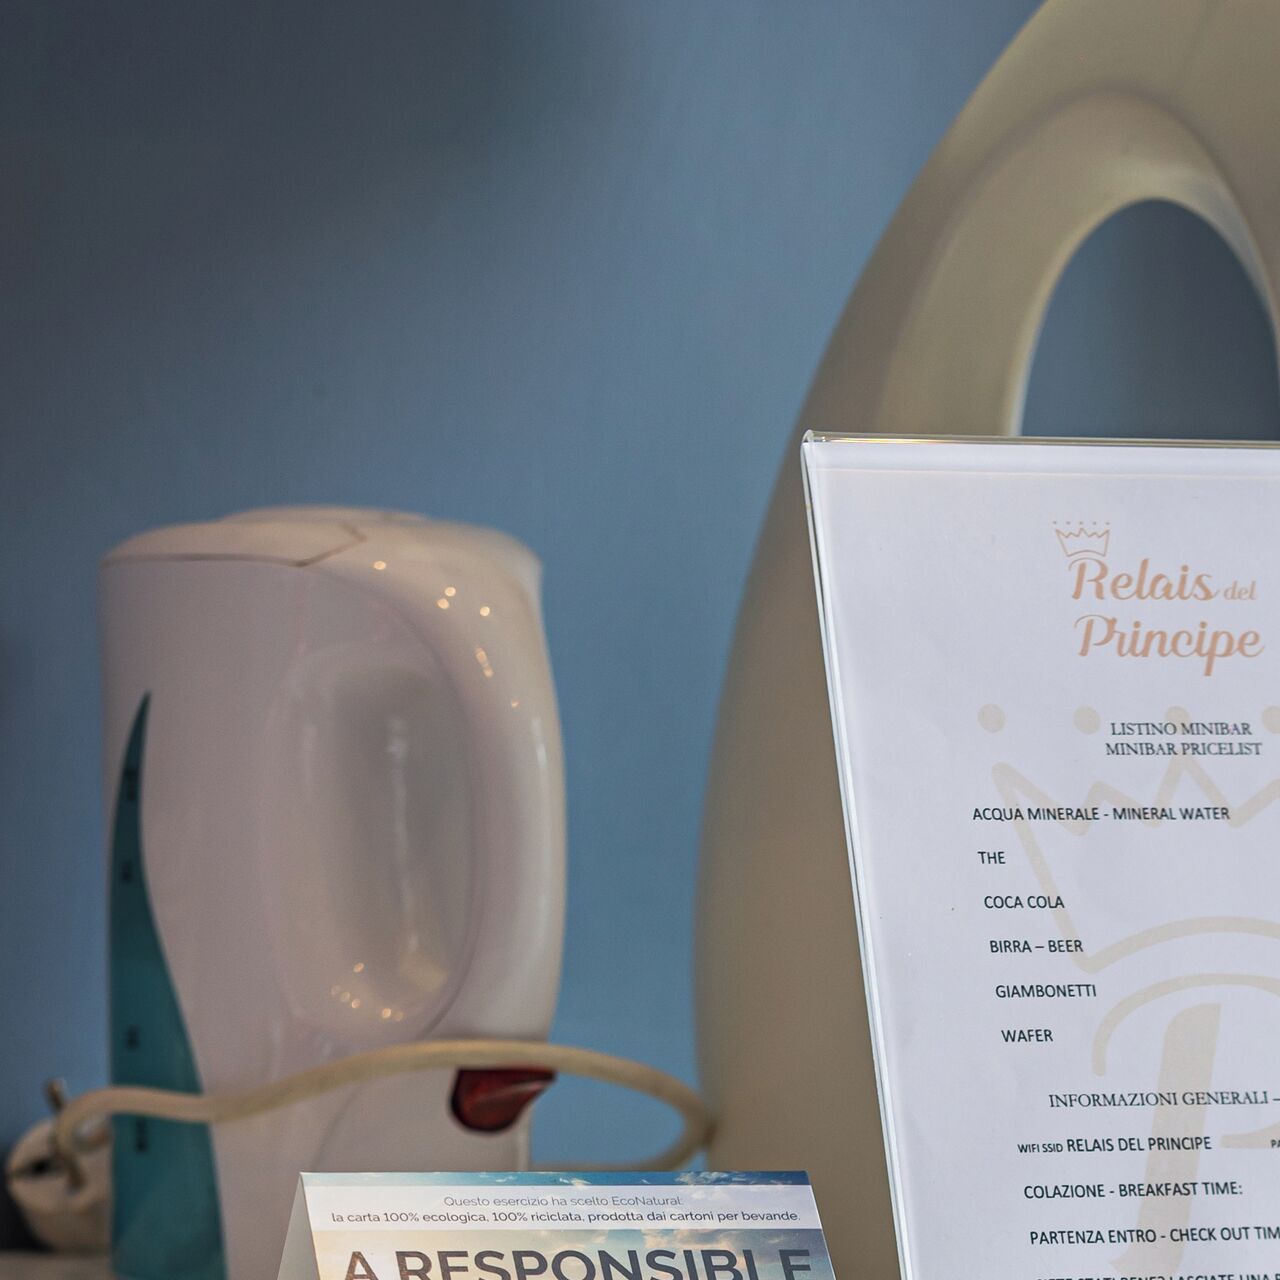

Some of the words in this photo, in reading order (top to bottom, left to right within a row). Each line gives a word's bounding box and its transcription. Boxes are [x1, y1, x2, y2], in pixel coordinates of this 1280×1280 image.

[1068, 557, 1220, 601] Relais
[1223, 580, 1257, 601] del
[1074, 614, 1266, 677] Principe
[1111, 722, 1177, 736] LISTINO
[1181, 722, 1252, 736] MINIBAR
[1105, 742, 1178, 756] MINIBAR
[1181, 742, 1263, 756] PRICELIST
[972, 807, 1024, 822] ACQUA
[1028, 807, 1100, 821] MINERALE
[1113, 807, 1177, 820] MINERAL
[1179, 807, 1231, 820] WATER
[978, 851, 1006, 865] THE
[984, 895, 1024, 909] COCA
[1027, 895, 1065, 909] COLA
[989, 940, 1032, 953] BIRRA
[1048, 939, 1084, 952] BEER
[995, 984, 1097, 998] GIAMBONETTI
[1001, 1029, 1054, 1043] WAFER
[1048, 1092, 1178, 1108] INFORMAZIONI
[1182, 1091, 1268, 1106] GENERALI
[1017, 1143, 1040, 1153] WIFI
[1042, 1143, 1063, 1153] SSID
[1066, 1138, 1114, 1152] RELAIS
[1118, 1137, 1145, 1151] DEL
[1148, 1136, 1212, 1151] PRINCIPE
[1024, 1184, 1105, 1199] COLAZIONE
[1119, 1182, 1199, 1197] BREAKFAST
[1202, 1181, 1243, 1195] TIME:
[444, 1196, 490, 1207] Questo
[493, 1195, 549, 1206] esercizio
[552, 1196, 568, 1206] ha
[570, 1195, 608, 1206] scelto
[332, 1212, 345, 1222] la
[347, 1213, 381, 1222] carta
[384, 1212, 419, 1222] 100%
[423, 1212, 490, 1224] ecologica,
[493, 1211, 528, 1222] 100%
[531, 1211, 586, 1223] riciclata,
[588, 1211, 644, 1223] prodotta
[647, 1211, 667, 1221] dai
[670, 1211, 714, 1221] cartoni
[718, 1212, 739, 1223] per
[742, 1210, 801, 1221] bevande.
[1030, 1230, 1105, 1245] PARTENZA
[1108, 1229, 1157, 1243] ENTRO
[1170, 1228, 1216, 1242] CHECK
[1220, 1226, 1251, 1240] OUT
